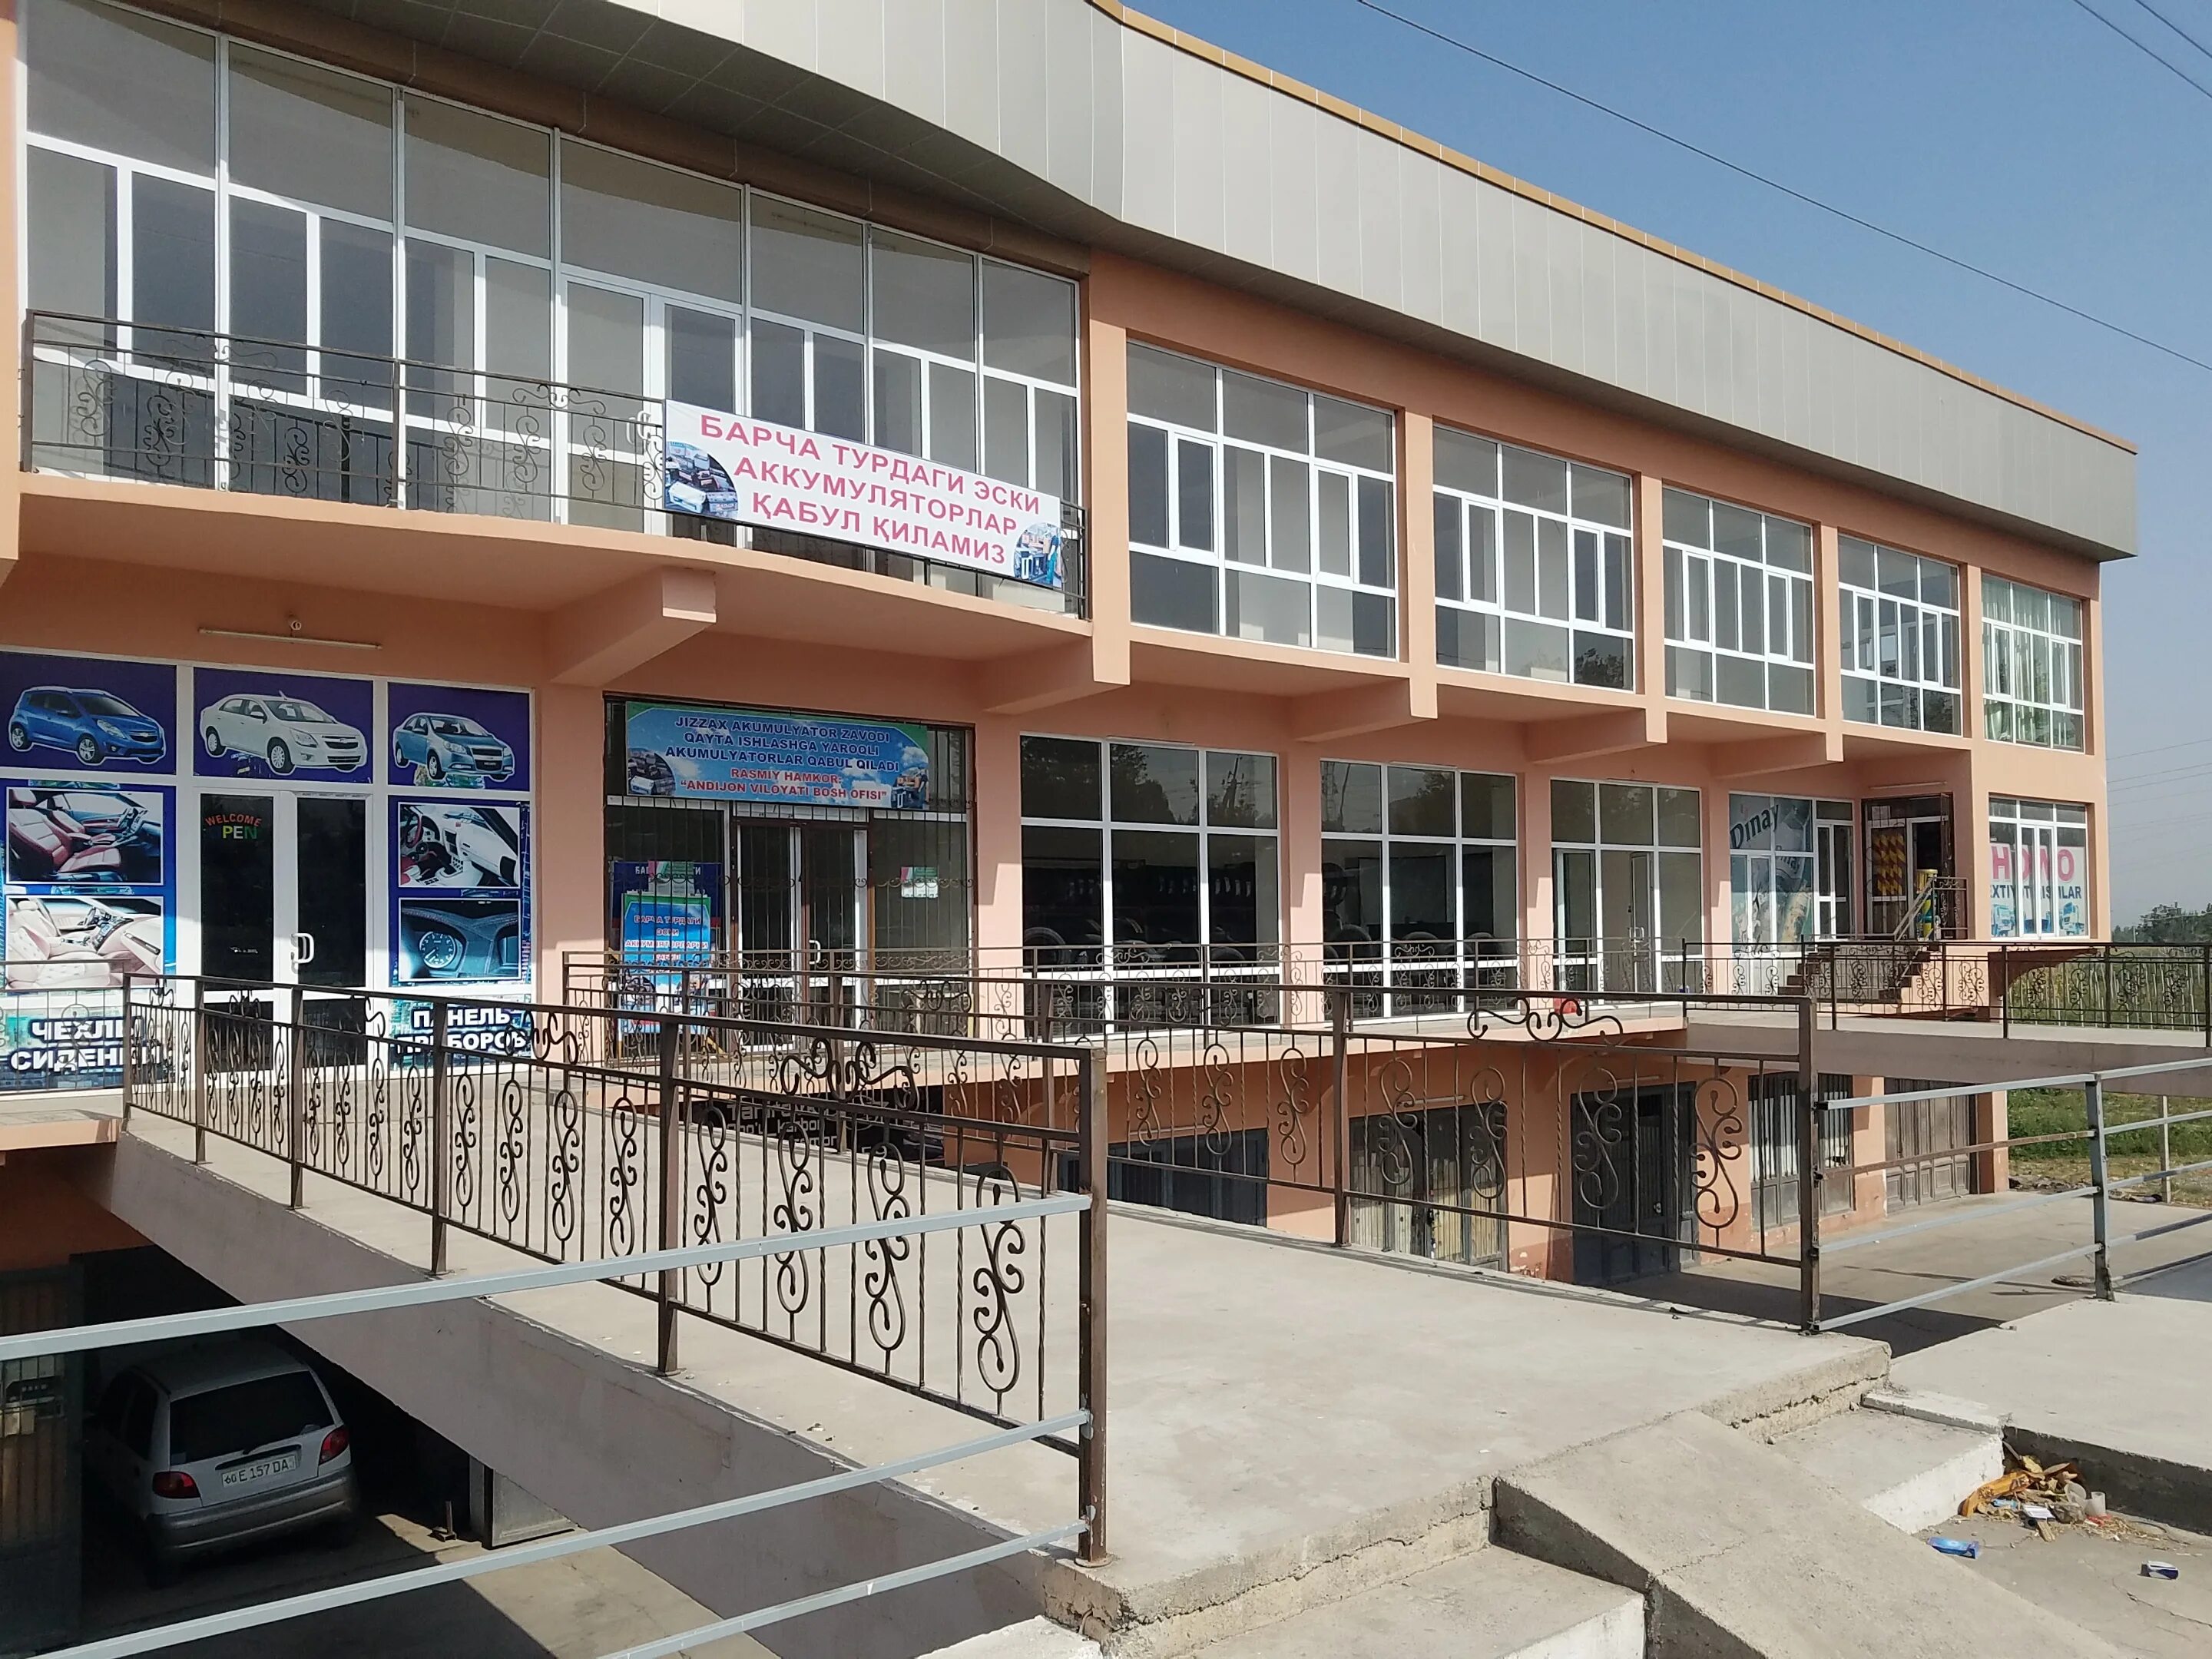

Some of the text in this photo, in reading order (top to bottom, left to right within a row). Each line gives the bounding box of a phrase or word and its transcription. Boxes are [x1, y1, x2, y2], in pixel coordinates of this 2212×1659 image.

[700, 414, 1039, 515] БАРЧА ТУРДАГИ ЭСКИ
[733, 456, 1017, 535] АККУМУЛЯТОРЛАР
[753, 492, 1005, 565] ҚАБУЛ ҚИЛАМИЗ
[675, 717, 890, 743] JIZZAX AKUMULYATOR ZAVODI
[684, 732, 879, 757] QAYTA ISHLASHGA YAROQLI
[665, 746, 899, 772] AKUMULYATORLAR QABUL QILADI
[730, 768, 843, 784] RASMIY HAMKOR:
[750, 783, 810, 796] VILOYATI
[813, 787, 846, 798] BOSH
[204, 813, 263, 827] WELCOME
[209, 825, 258, 839] PEN
[413, 1008, 512, 1028] ПНЕЛЬ
[396, 1031, 527, 1054] ПРБОРОВ
[238, 1469, 248, 1482] E
[250, 1463, 270, 1480] 157
[272, 1459, 290, 1473] DA
